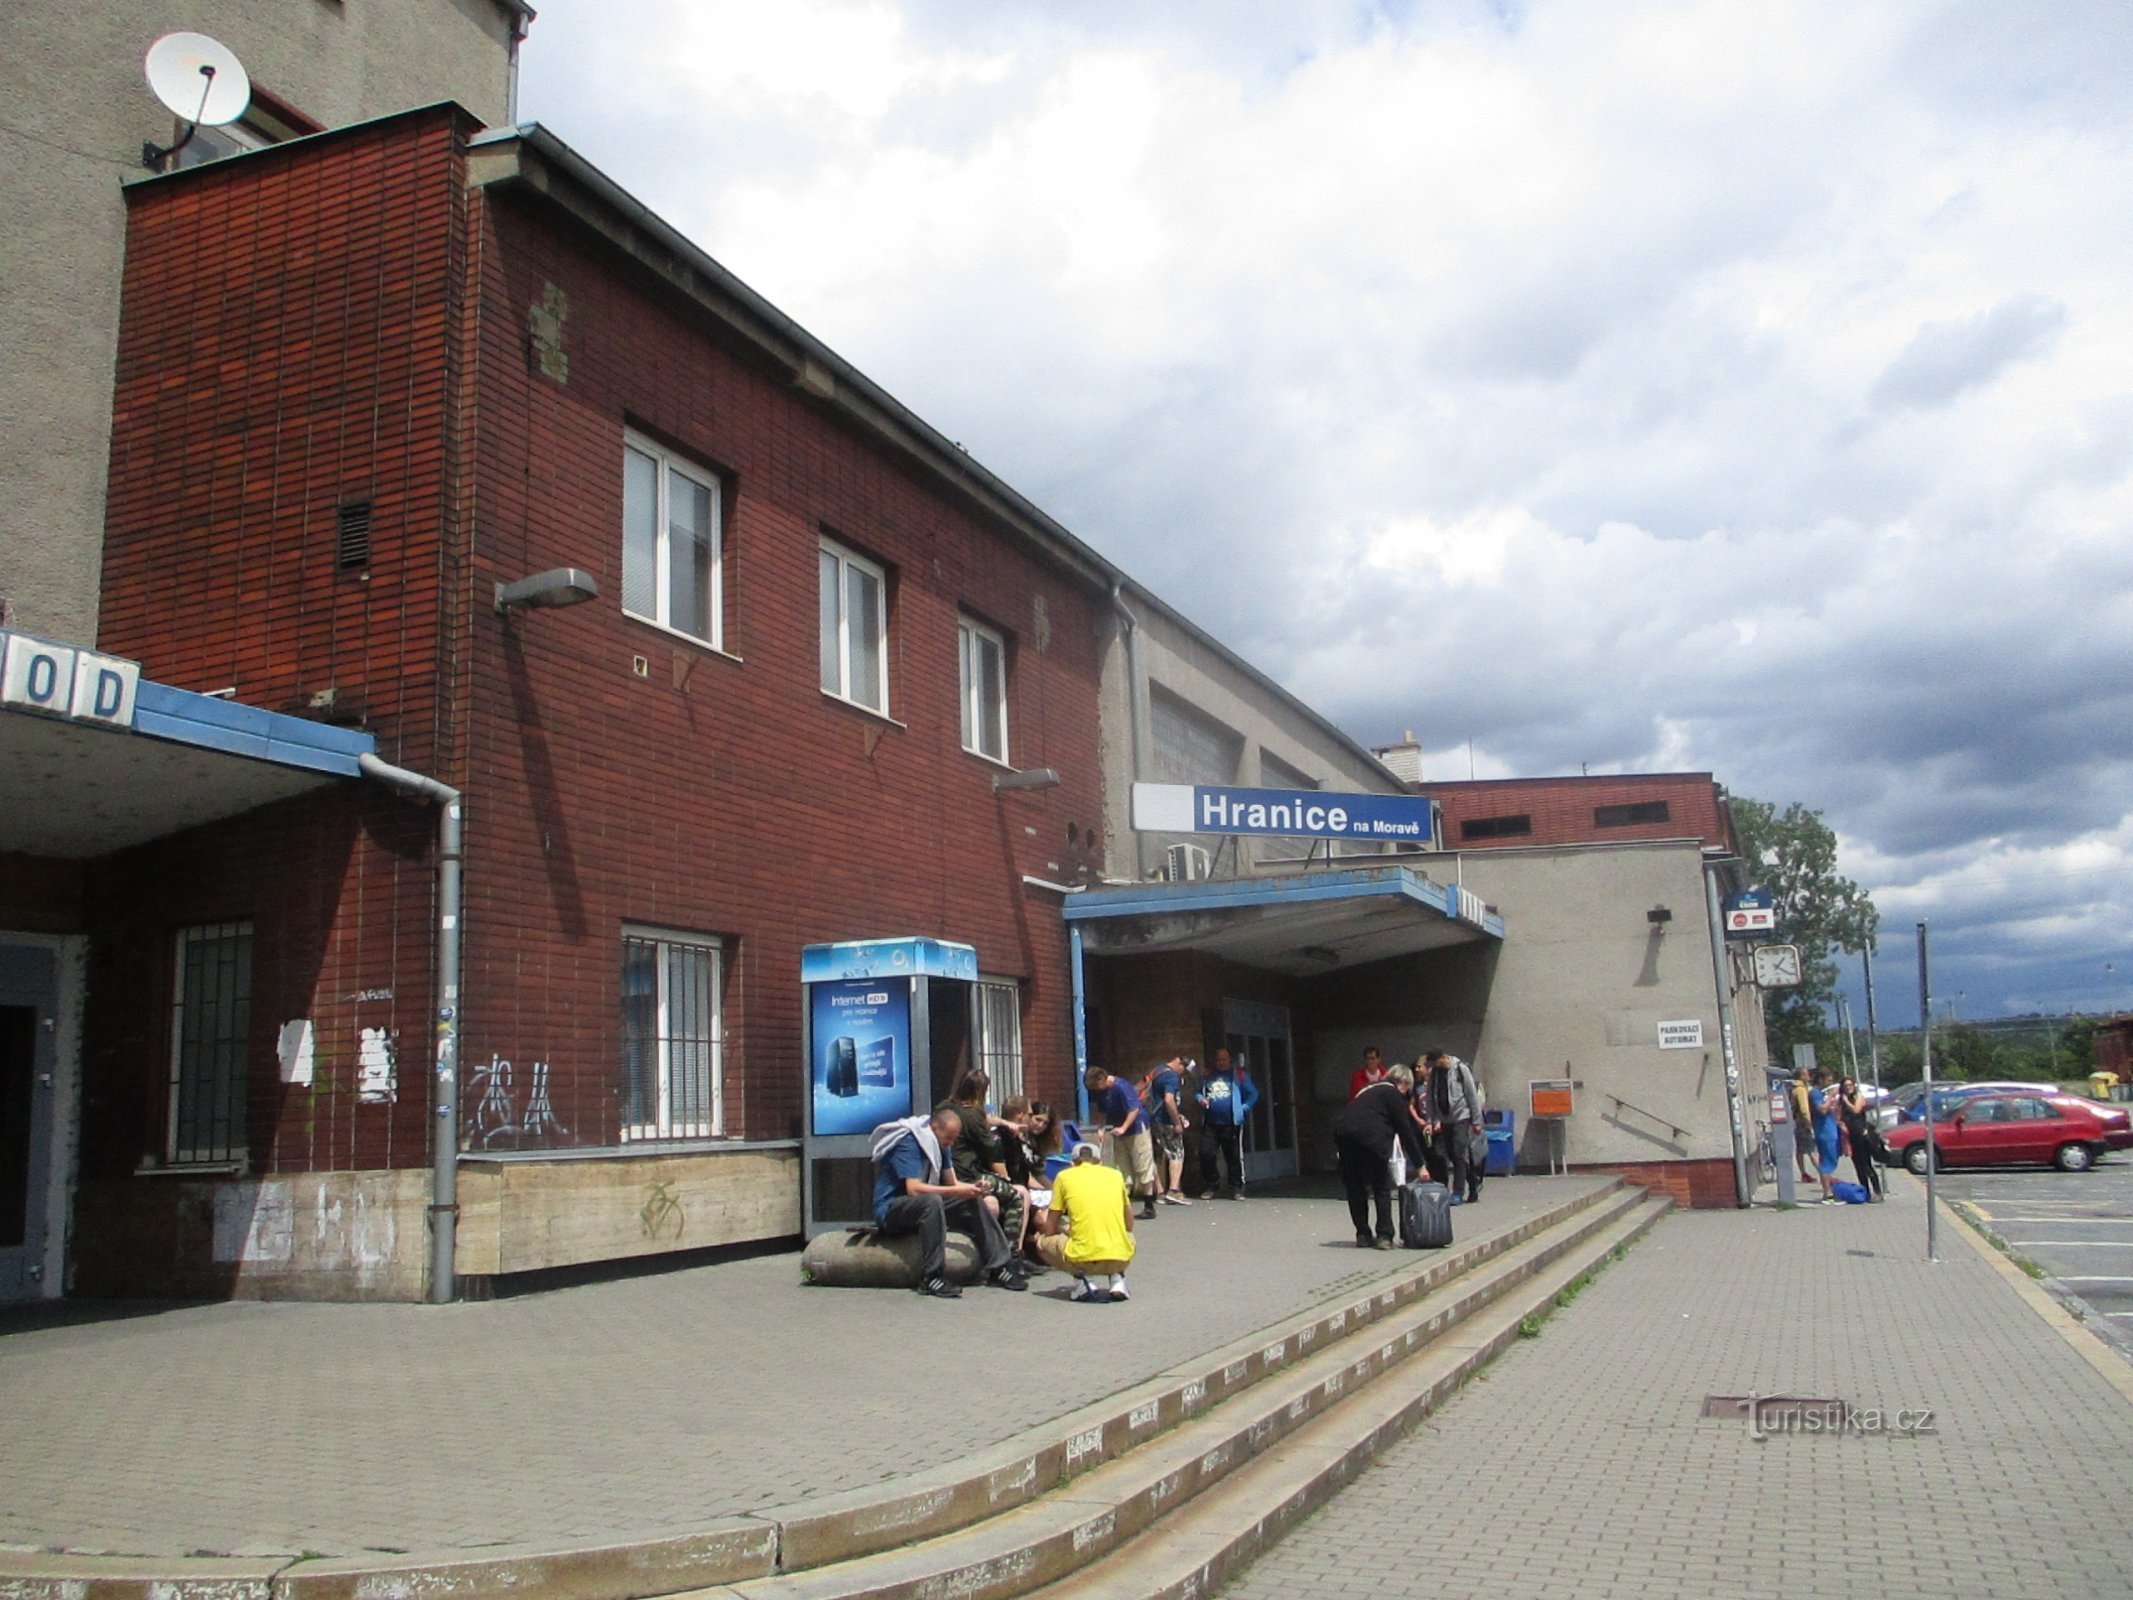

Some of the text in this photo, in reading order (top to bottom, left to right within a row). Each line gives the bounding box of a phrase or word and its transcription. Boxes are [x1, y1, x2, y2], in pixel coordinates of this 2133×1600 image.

[1203, 794, 1420, 835] Hranice na Moravě
[831, 995, 865, 1006] Internet
[1664, 1035, 1697, 1044] AUTOMAT
